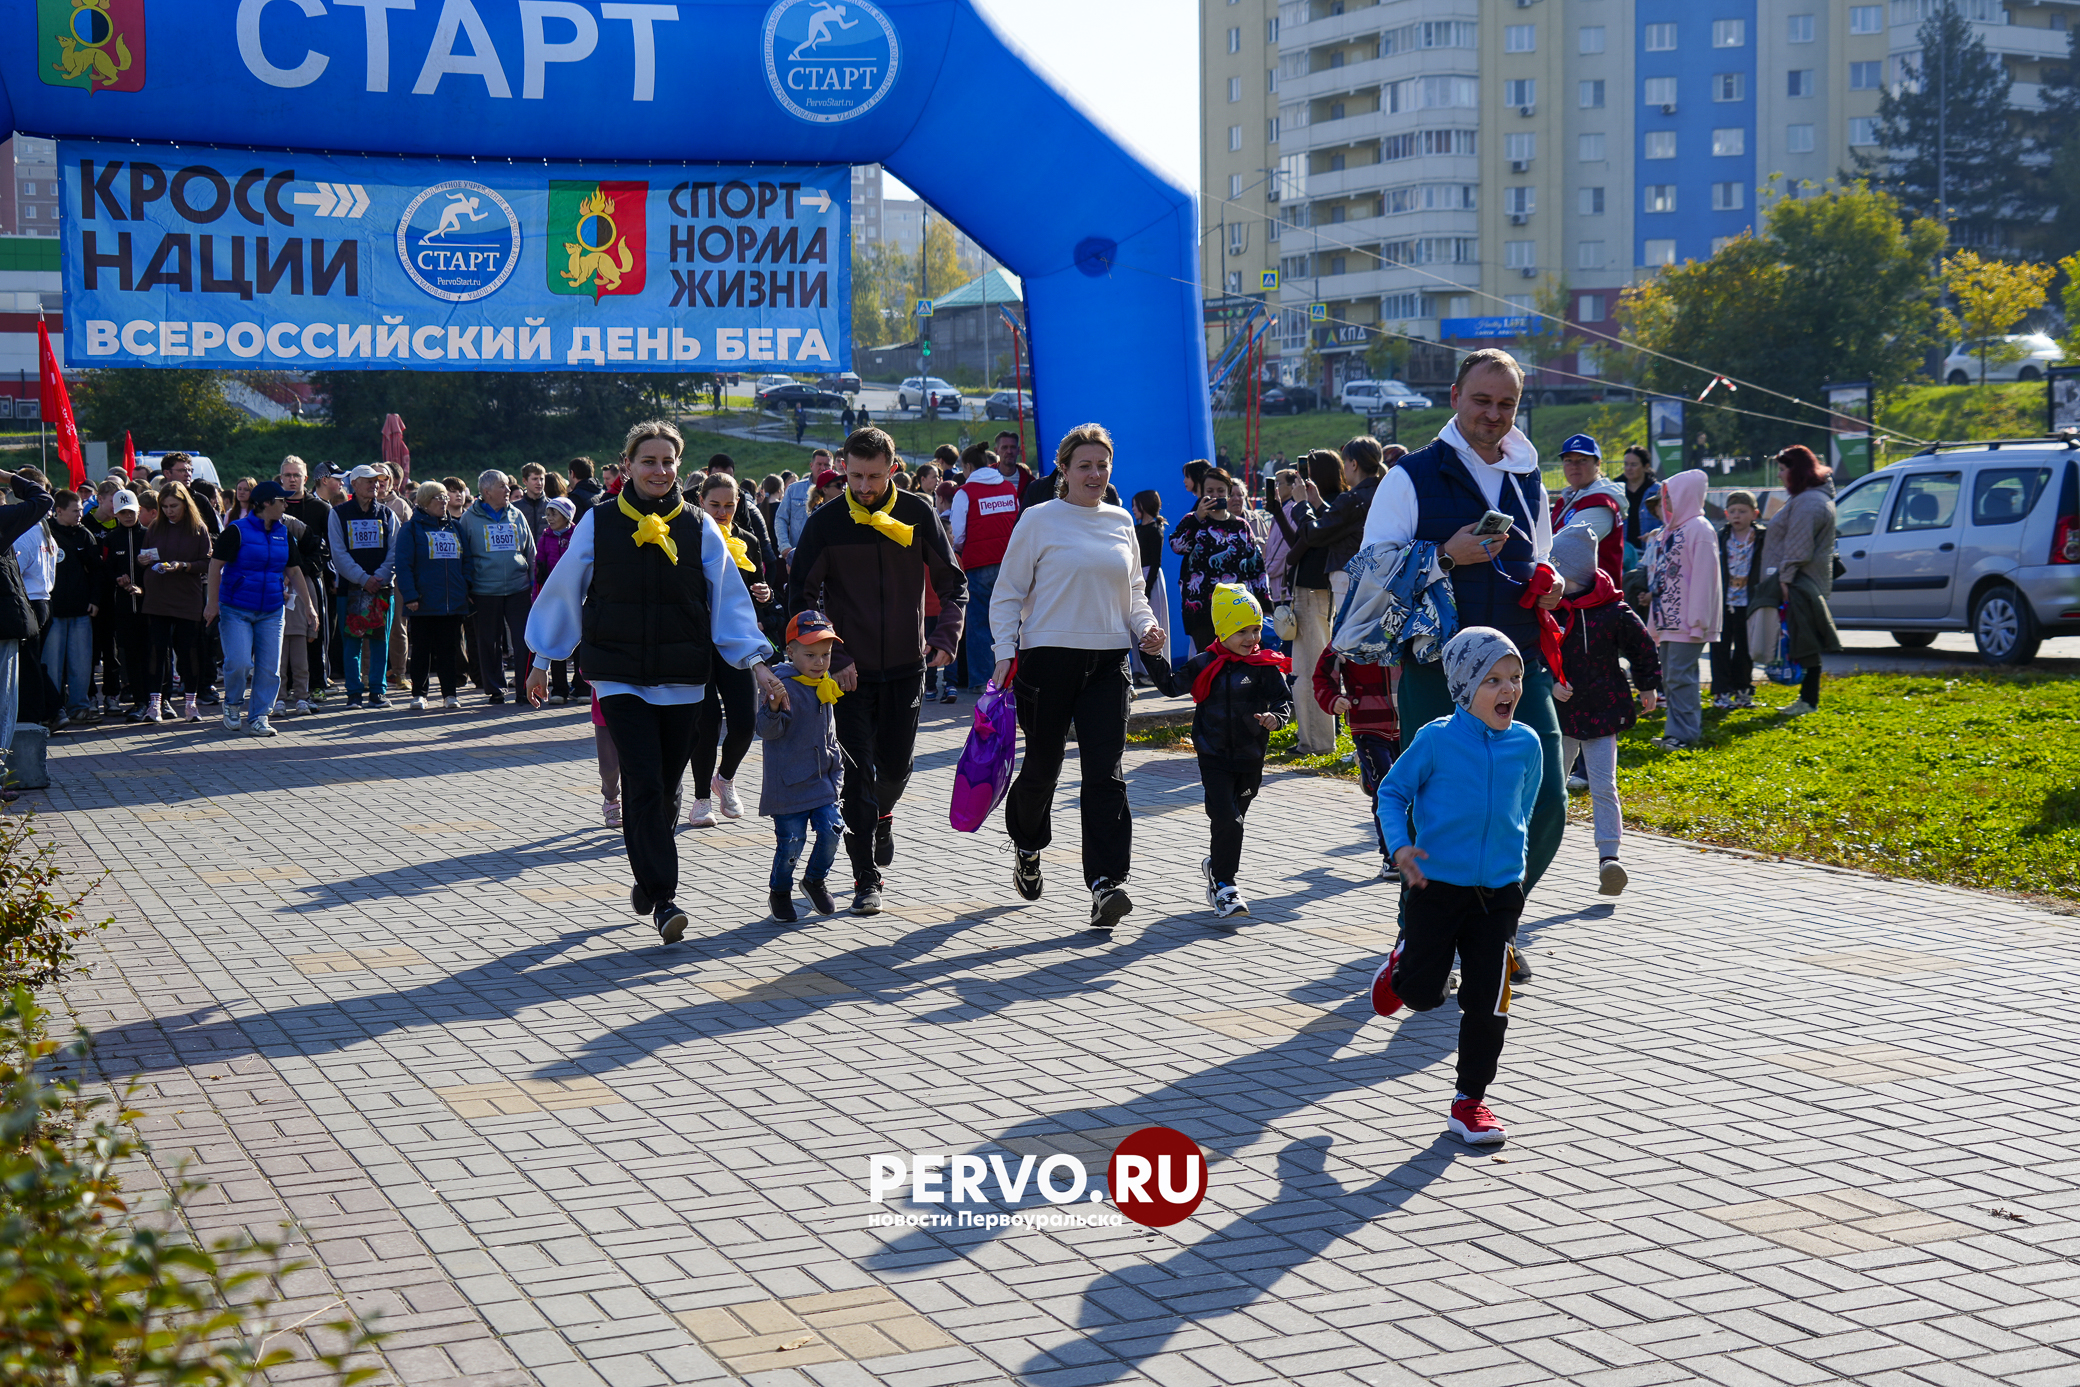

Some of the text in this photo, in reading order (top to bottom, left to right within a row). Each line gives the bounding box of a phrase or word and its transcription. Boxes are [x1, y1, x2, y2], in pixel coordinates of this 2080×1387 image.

[235, 0, 680, 102] СТАРТ
[787, 67, 877, 90] СТАРТ
[806, 98, 854, 107] PervoStart.ru
[80, 159, 295, 227] КРОСС
[668, 180, 801, 220] СПОРТ
[669, 225, 828, 265] НОРМА
[82, 230, 358, 301] НАЦИИ
[417, 251, 500, 271] СТАРТ
[437, 277, 482, 286] PervoStart.ru
[668, 270, 828, 308] ЖИЗНИ
[86, 315, 832, 366] ВСЕРОССИЙСКИЙ ДЕНЬ БЕГА
[1339, 326, 1367, 342] КПД
[980, 500, 1014, 511] Первые
[354, 531, 377, 541] 18877
[490, 534, 514, 544] 18507
[435, 542, 456, 552] 18277
